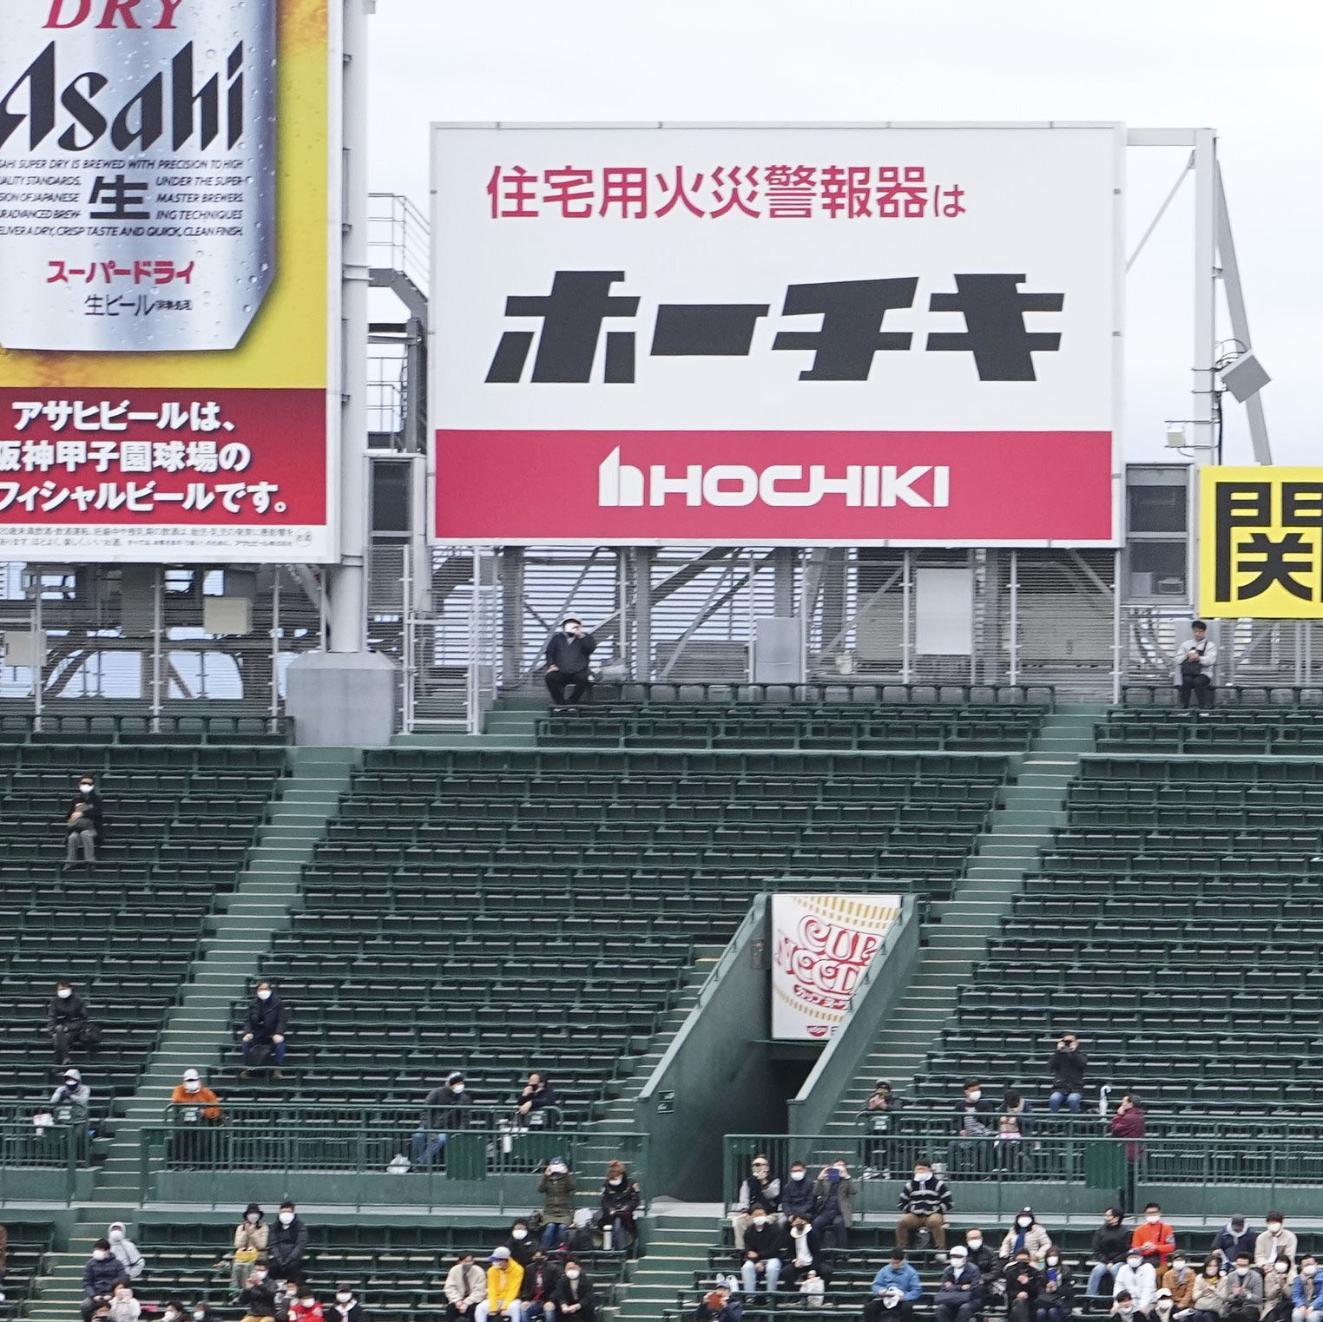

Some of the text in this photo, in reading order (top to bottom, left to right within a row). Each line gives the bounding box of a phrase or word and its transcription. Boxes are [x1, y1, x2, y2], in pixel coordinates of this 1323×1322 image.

[0, 40, 245, 152] Asahi
[88, 175, 150, 219] 生
[485, 164, 966, 219] 住宅用火災警報器は
[46, 260, 195, 284] スーパードライ
[484, 270, 1065, 383] ホーチキ
[12, 400, 235, 432] アサヒビールは、
[658, 464, 950, 508] HOCHIKI
